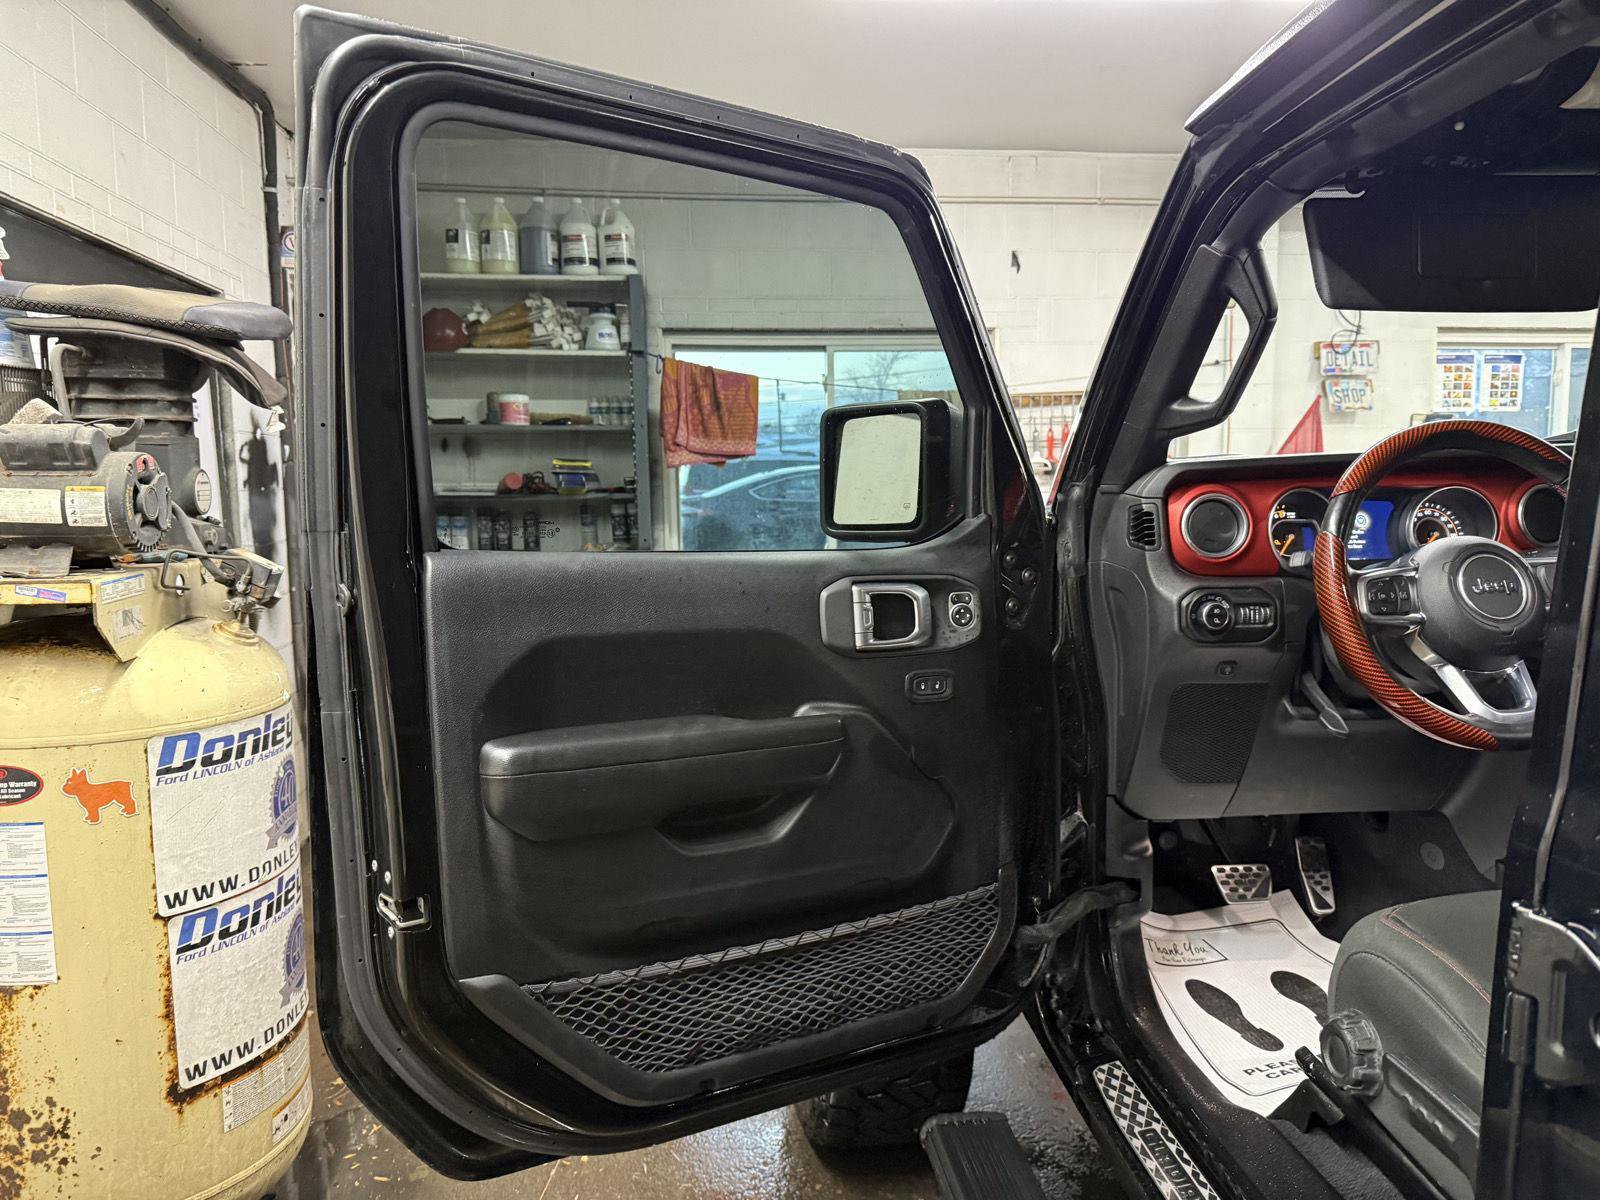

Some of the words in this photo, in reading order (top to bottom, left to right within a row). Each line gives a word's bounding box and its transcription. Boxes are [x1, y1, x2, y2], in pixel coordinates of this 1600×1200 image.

[1326, 350, 1374, 367] DETAIL
[1334, 388, 1366, 404] SHOP
[1472, 577, 1518, 595] Jeep
[156, 711, 293, 777] Donley
[156, 772, 188, 787] Ford
[193, 759, 241, 780] LINCOLN
[245, 755, 255, 768] of
[176, 947, 207, 965] Ford
[211, 928, 257, 954] LINCOLN
[259, 920, 269, 933] of
[1144, 937, 1183, 956] Thank
[1183, 941, 1209, 957] You
